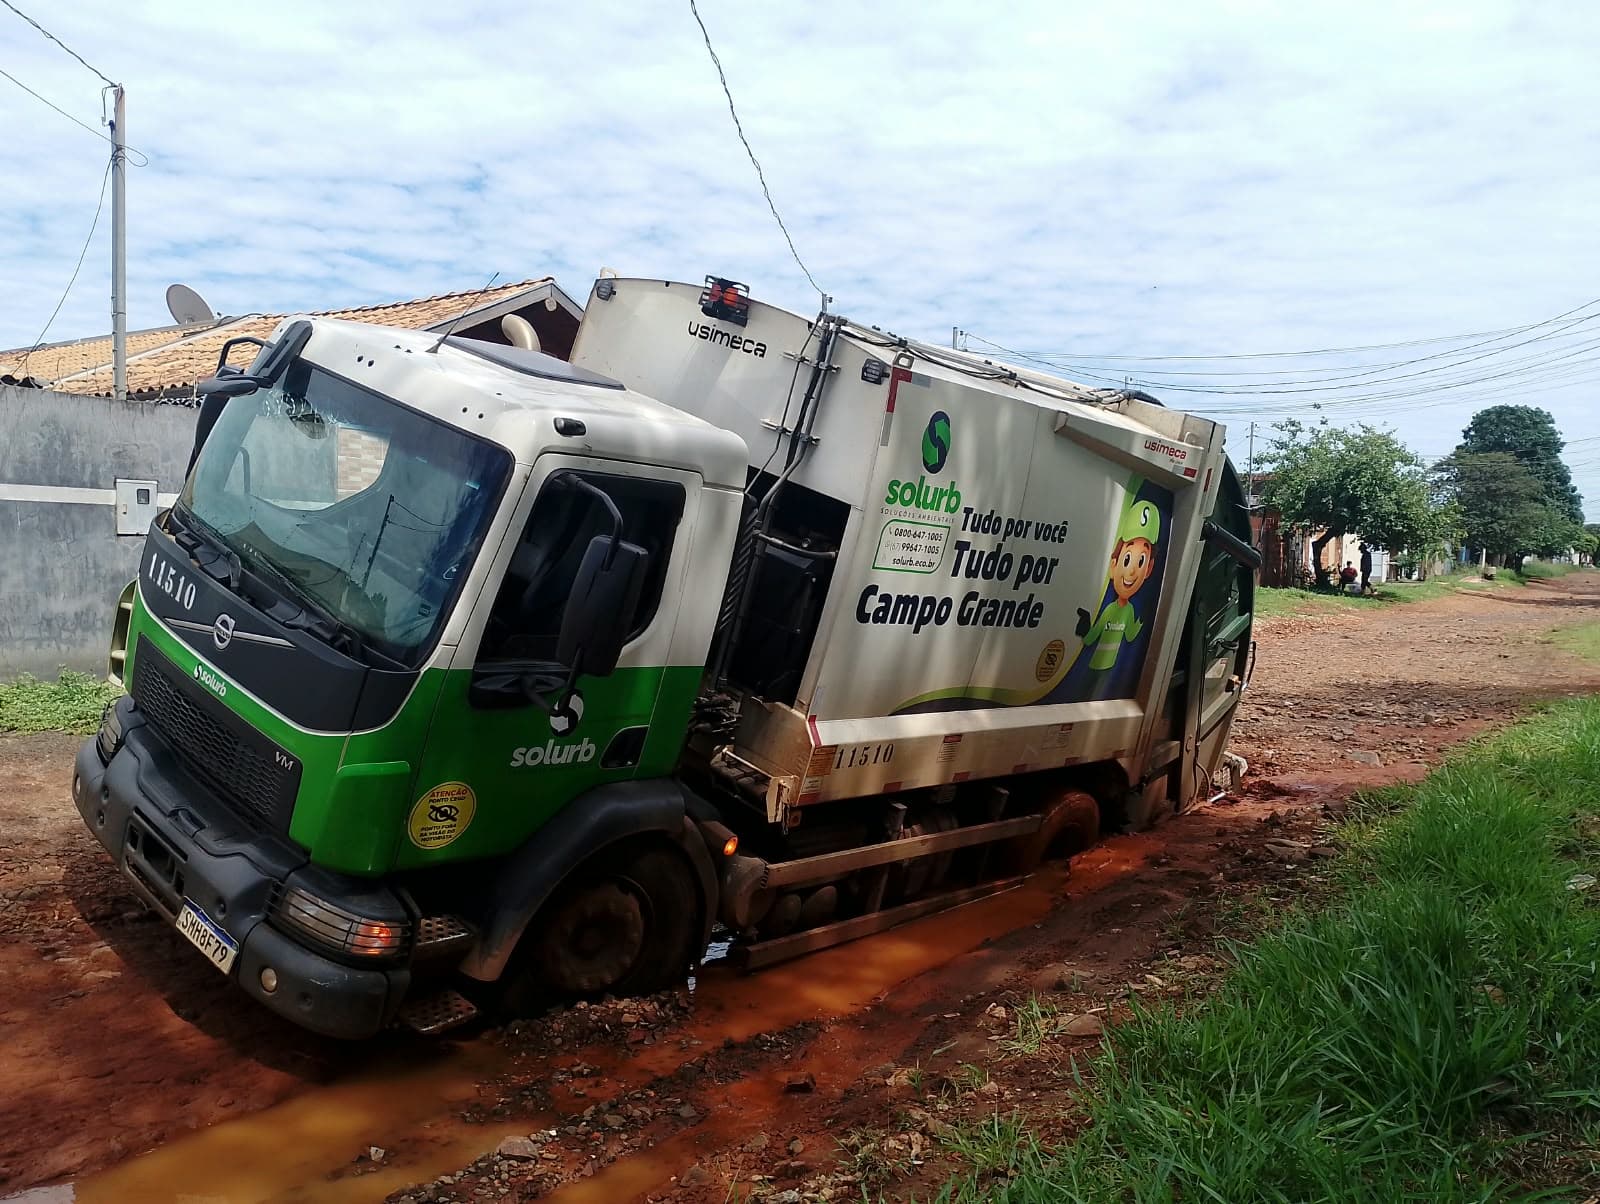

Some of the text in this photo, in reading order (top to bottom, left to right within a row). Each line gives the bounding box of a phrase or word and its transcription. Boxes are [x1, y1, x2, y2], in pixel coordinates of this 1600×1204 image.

[688, 321, 767, 358] usimeca
[1144, 440, 1187, 460] usimeca
[885, 475, 961, 514] solurb
[894, 527, 943, 542] 0800-647-1005
[961, 507, 1069, 544] Tudo por você
[892, 556, 936, 569] solurb.eco.br
[901, 542, 940, 555] 99647-1005
[951, 540, 1059, 590] Tudo por
[856, 584, 1044, 634] Campo Grande
[201, 670, 227, 697] solurb
[275, 751, 294, 771] VM
[510, 737, 597, 767] solurb
[182, 911, 228, 963] SHH8F79
